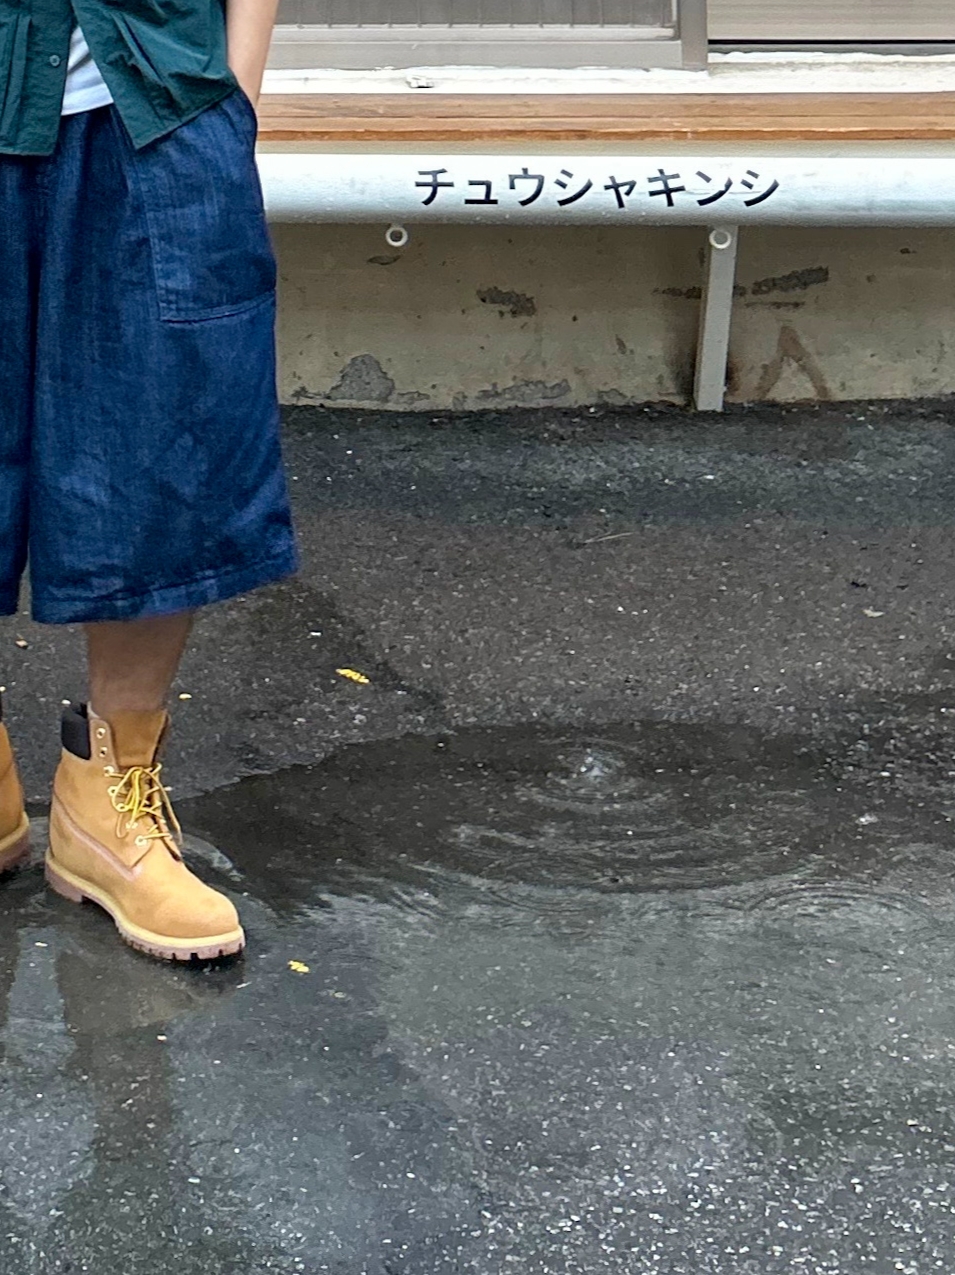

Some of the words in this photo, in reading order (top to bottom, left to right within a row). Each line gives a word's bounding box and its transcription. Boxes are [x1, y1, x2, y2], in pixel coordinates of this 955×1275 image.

[415, 167, 780, 209] チュウシャキンシ
